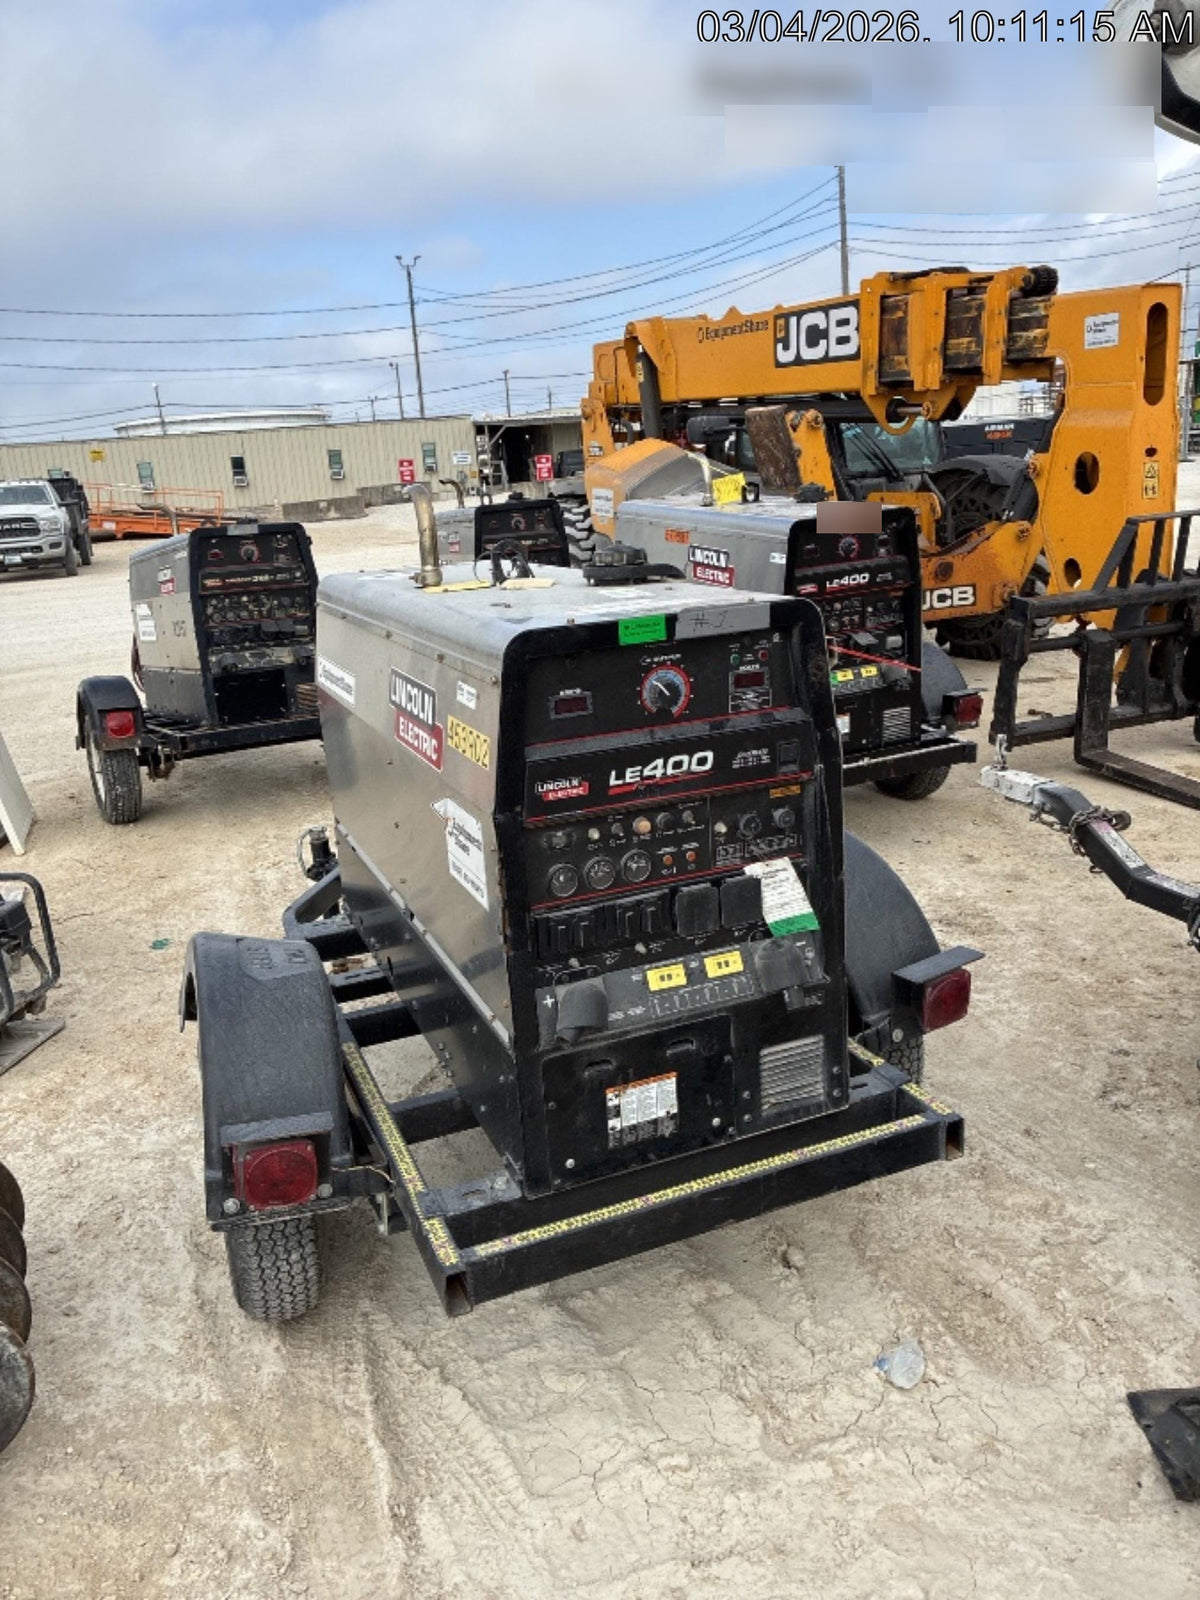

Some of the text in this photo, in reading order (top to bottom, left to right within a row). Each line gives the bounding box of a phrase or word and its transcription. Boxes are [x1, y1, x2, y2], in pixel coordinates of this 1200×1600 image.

[776, 305, 860, 364] JCB
[689, 548, 728, 568] LINCOLN
[696, 567, 730, 584] ELECTRIC
[921, 586, 975, 610] JCB
[391, 674, 433, 726] LINCOLN
[399, 715, 438, 762] ELECTRIC
[609, 750, 714, 787] LE400
[538, 778, 580, 793] LINCOLN
